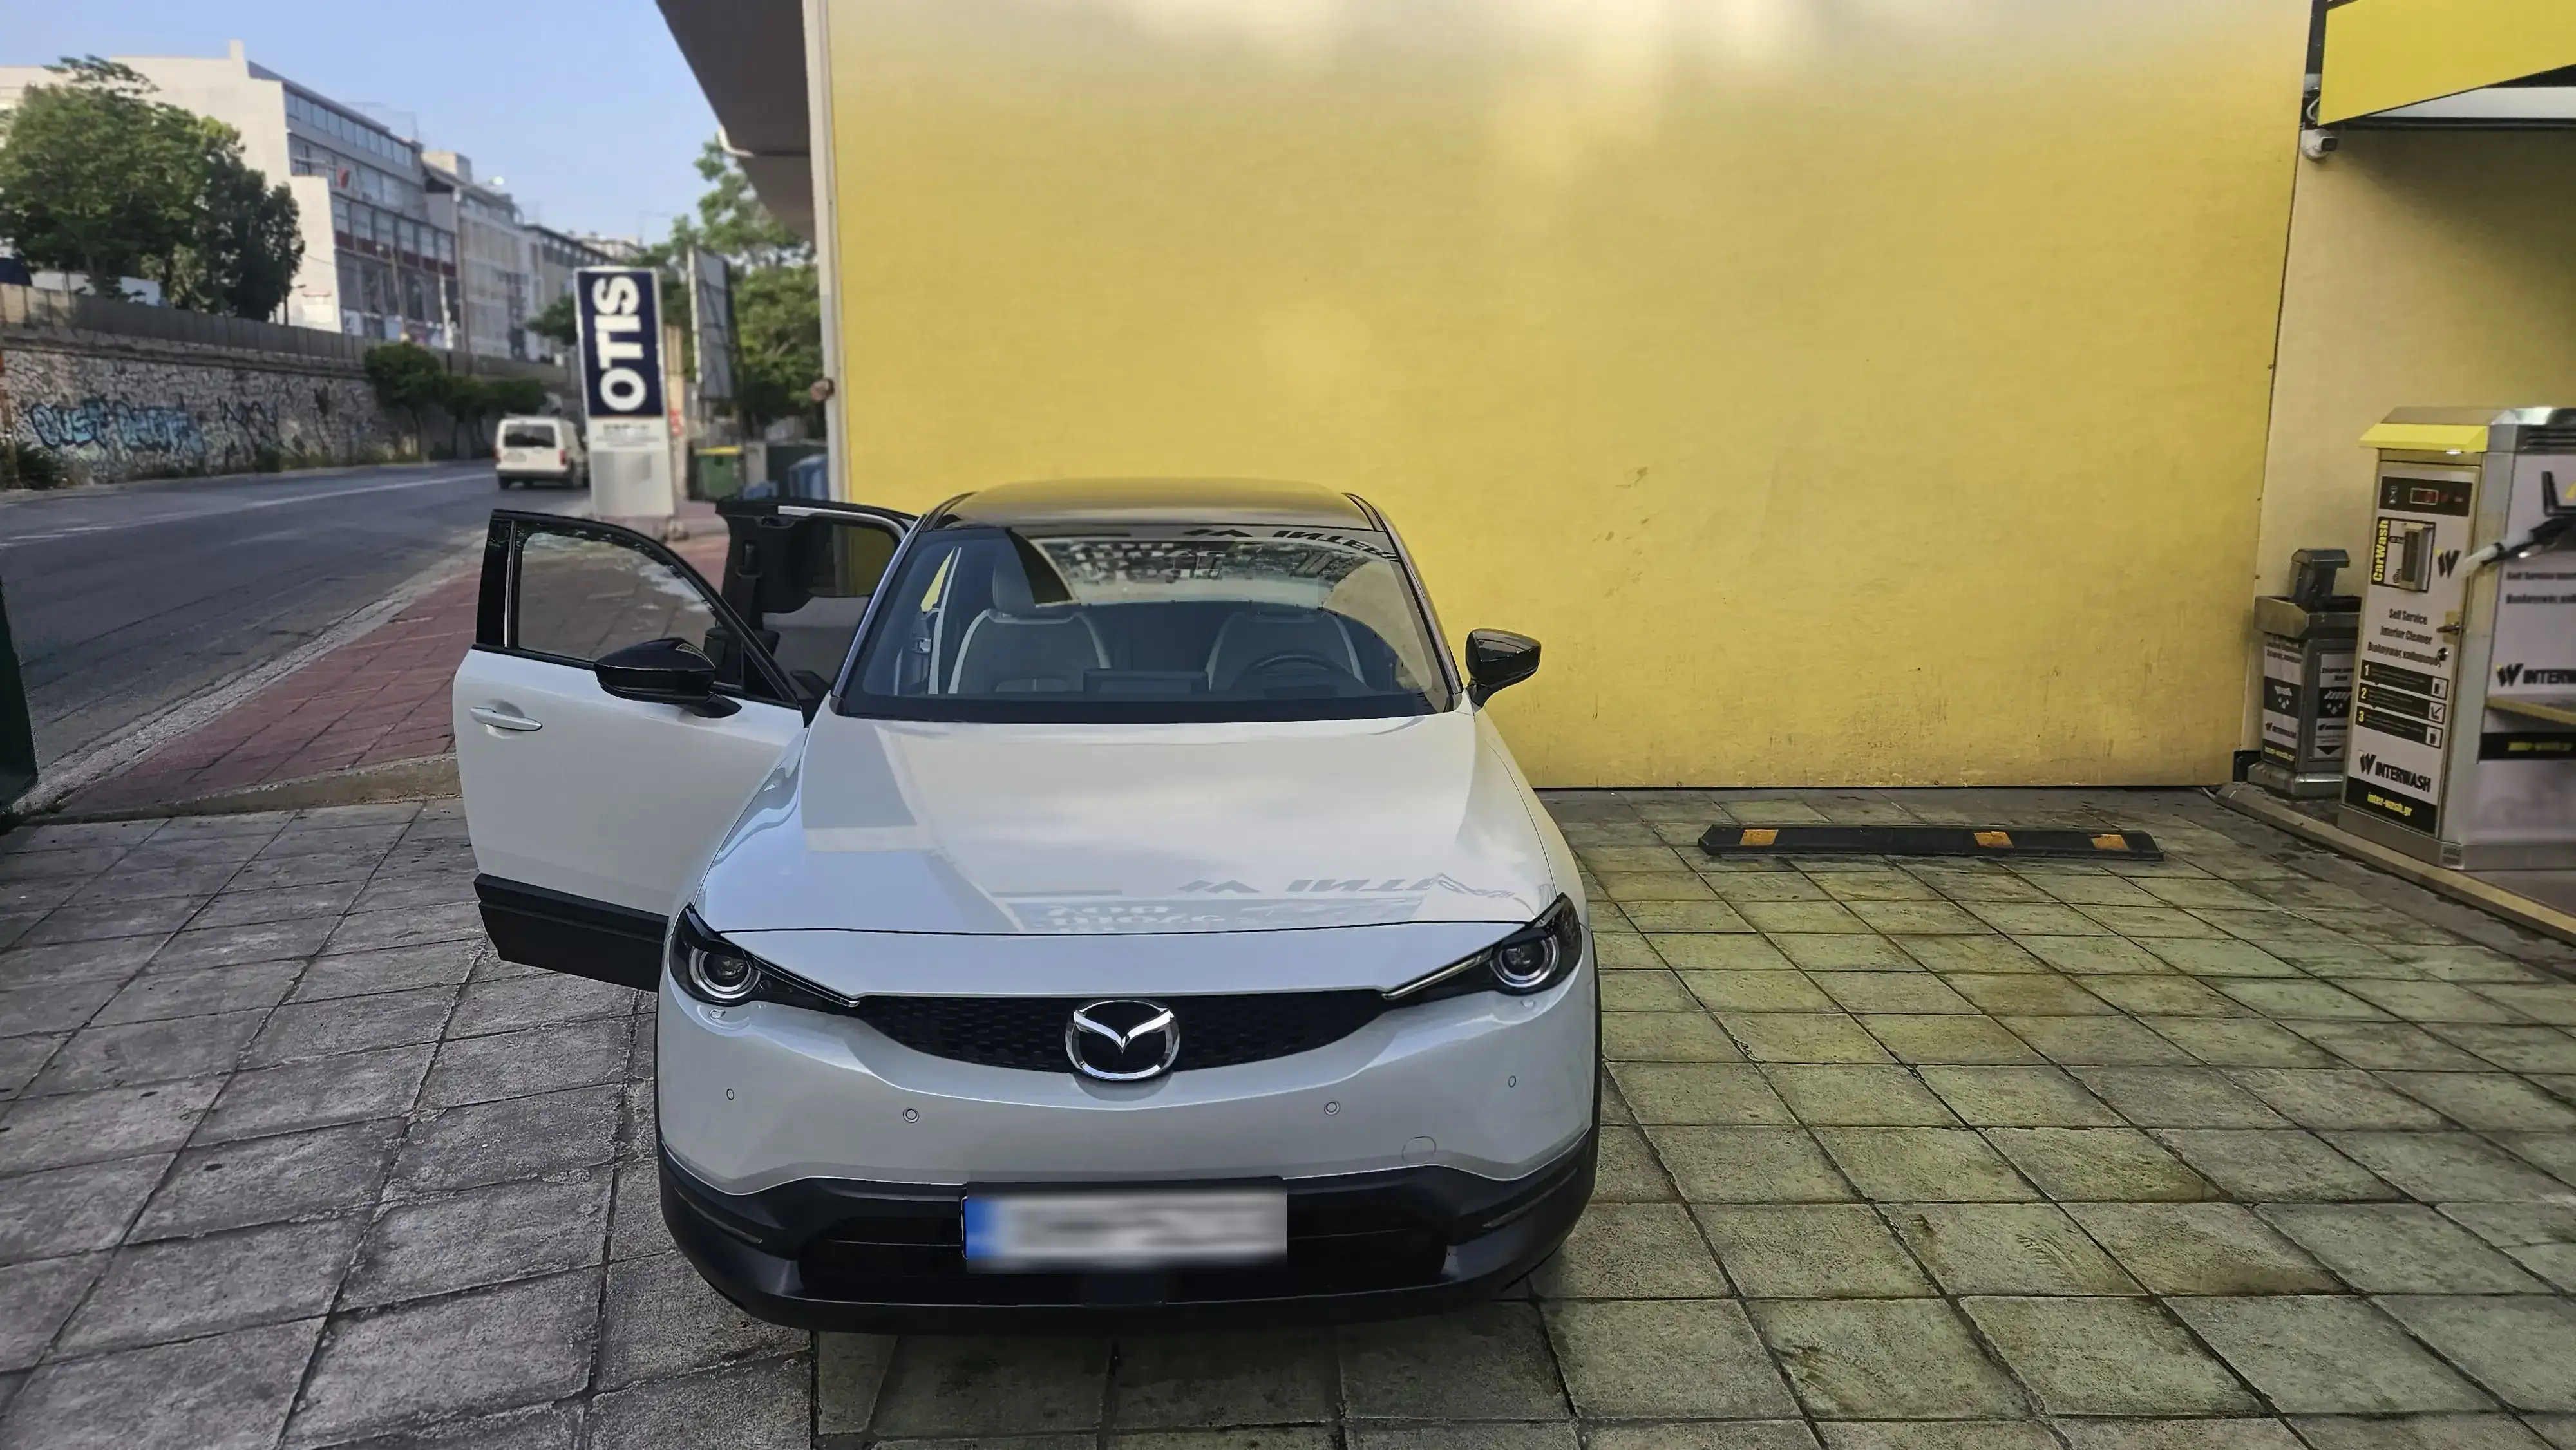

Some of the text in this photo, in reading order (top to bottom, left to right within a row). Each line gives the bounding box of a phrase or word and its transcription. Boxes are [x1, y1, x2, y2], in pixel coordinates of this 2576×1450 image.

[592, 276, 647, 411] OTIS
[2373, 520, 2389, 582] CarWash
[2402, 610, 2427, 625] Service
[2364, 664, 2371, 676] 1
[2361, 687, 2367, 699] 2
[2358, 710, 2364, 722] 3
[2374, 761, 2432, 793] INTERWASH
